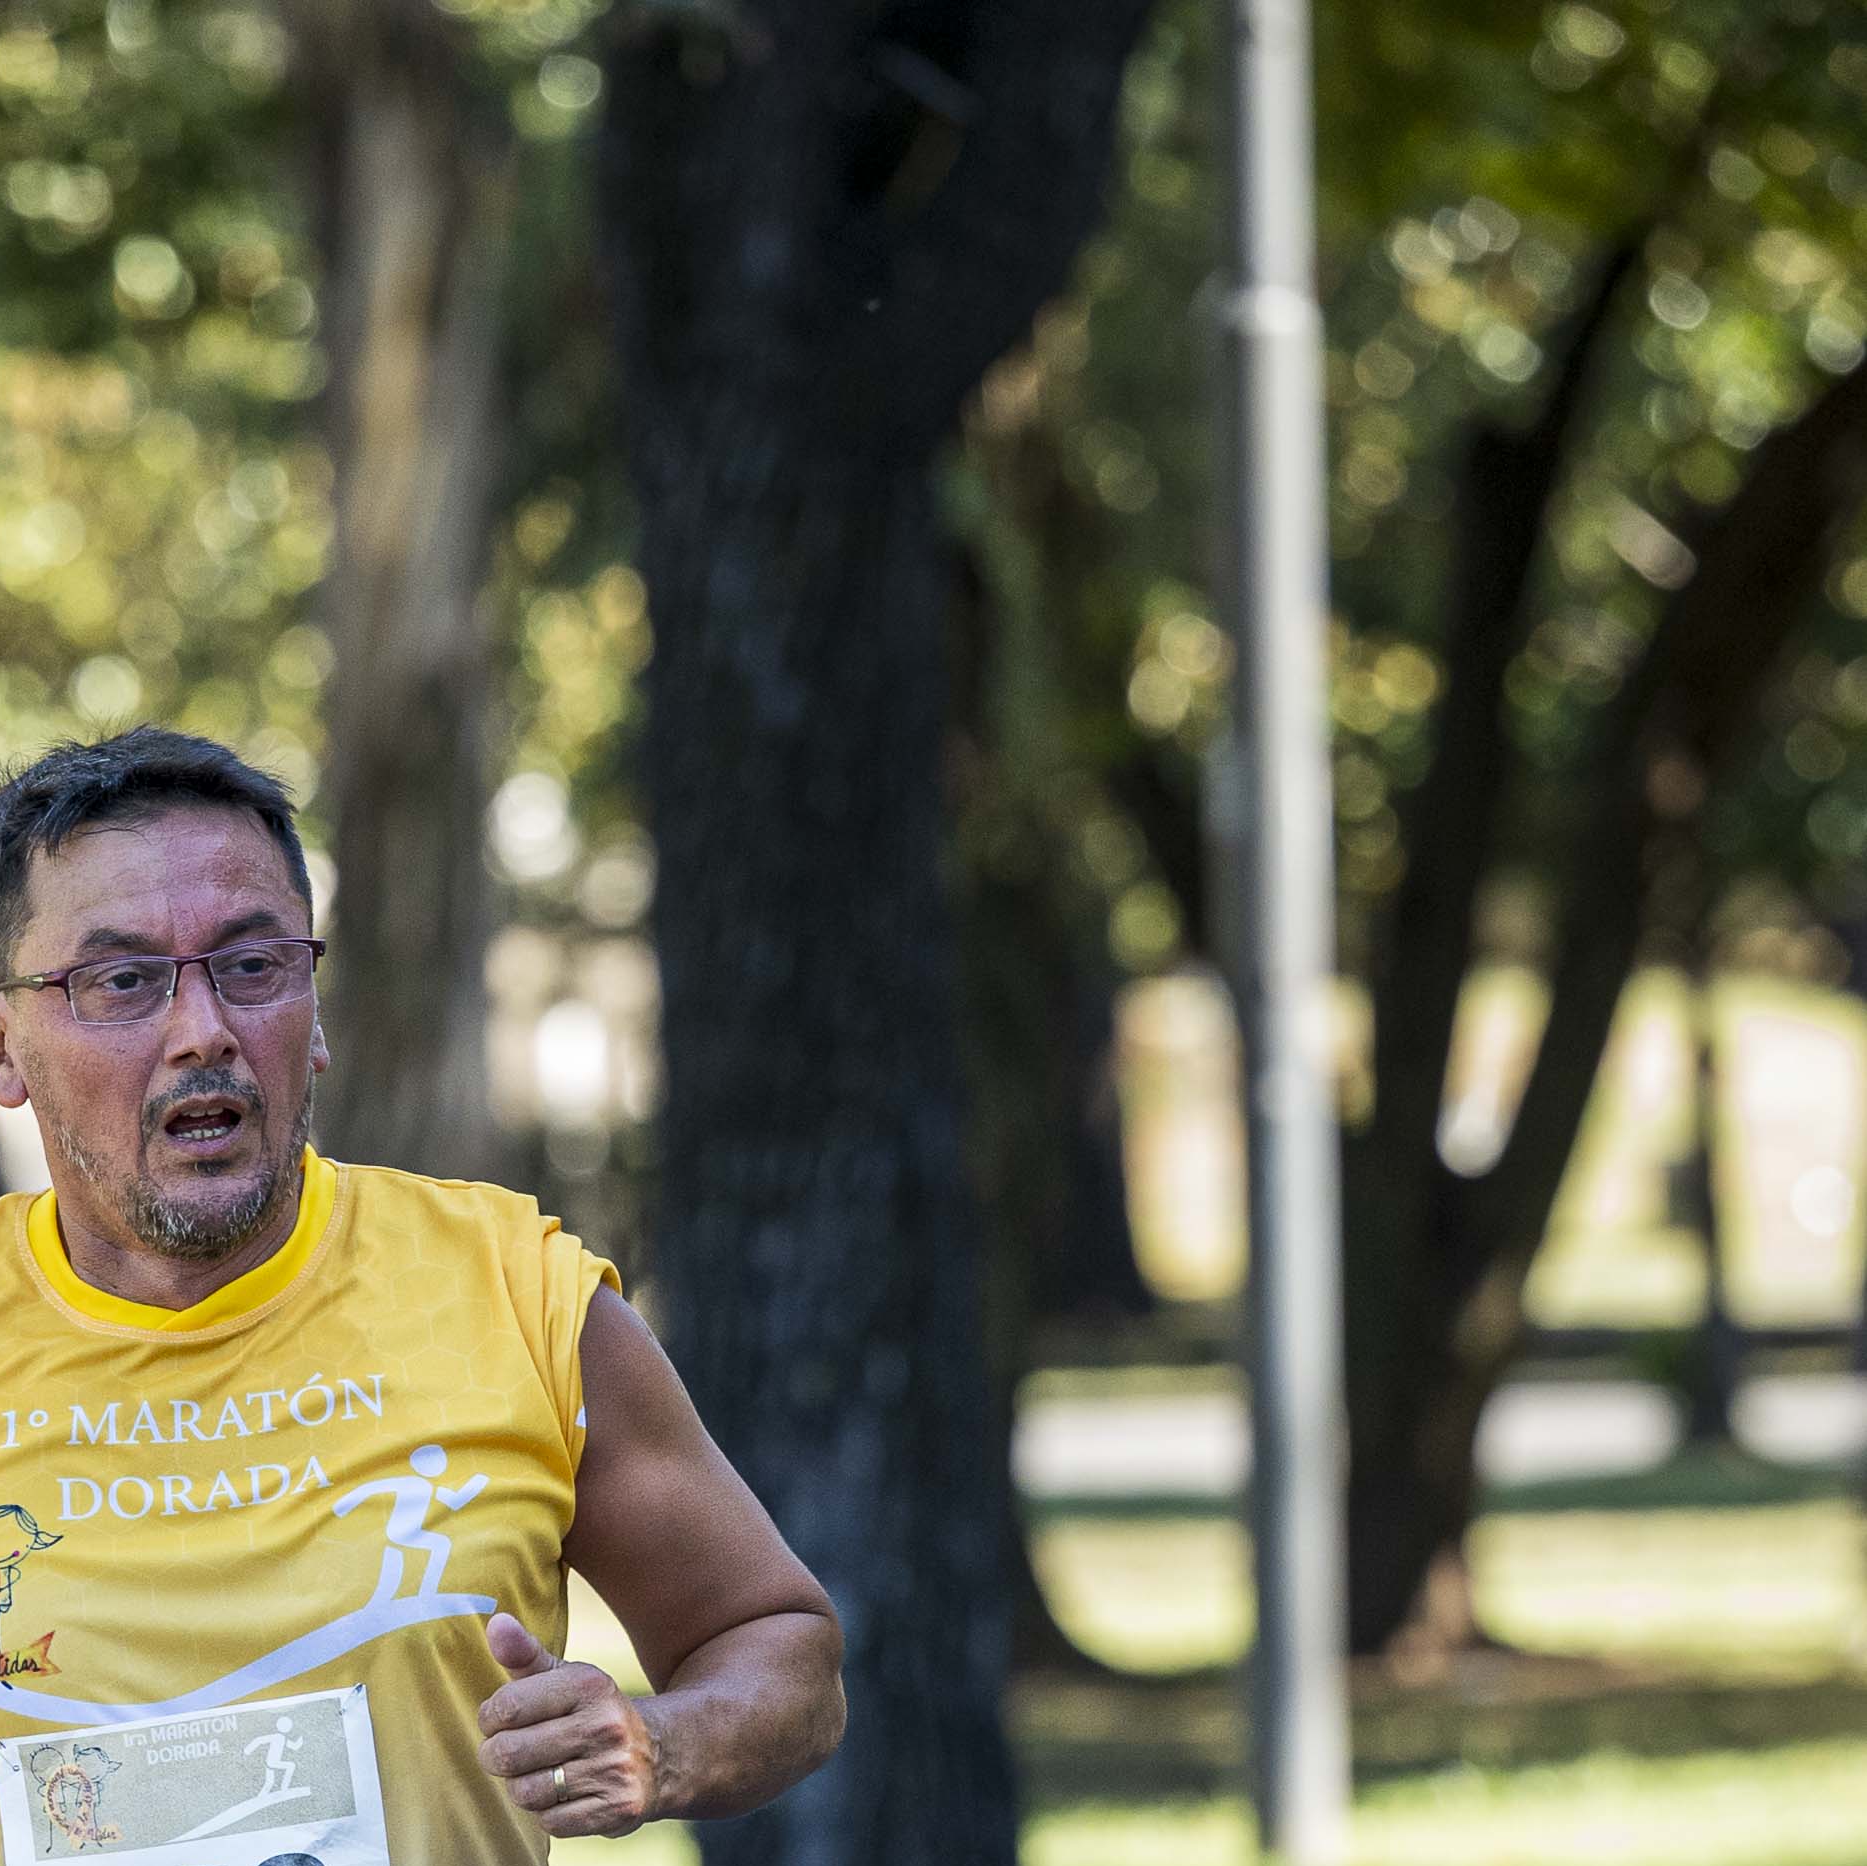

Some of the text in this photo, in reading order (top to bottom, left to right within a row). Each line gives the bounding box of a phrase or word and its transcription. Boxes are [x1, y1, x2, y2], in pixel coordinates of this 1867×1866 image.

[67, 1372, 385, 1444] MARATÓN
[57, 1456, 333, 1521] DORADA
[147, 1738, 222, 1765] DORADA
